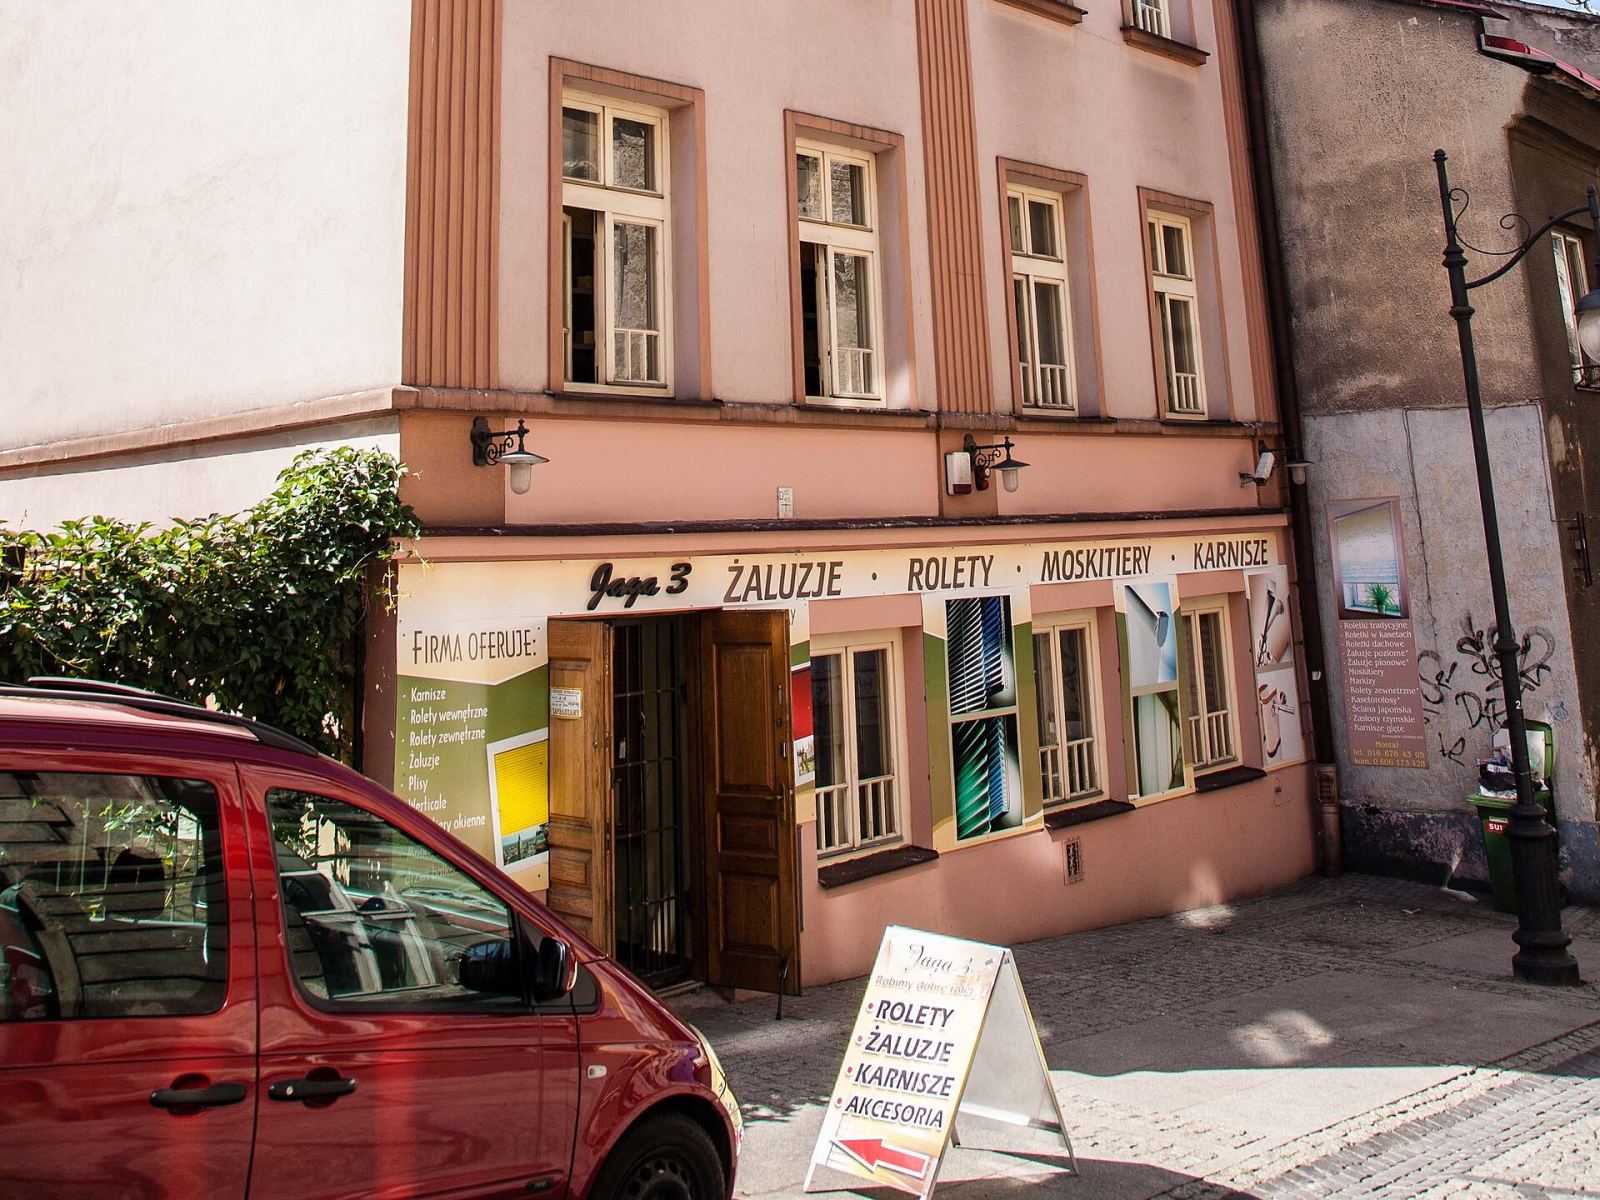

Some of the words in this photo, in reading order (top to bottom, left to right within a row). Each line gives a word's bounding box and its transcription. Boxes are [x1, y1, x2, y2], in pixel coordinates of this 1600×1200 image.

[723, 559, 843, 602] ŻALUZJE
[907, 555, 994, 591] ROLETY
[1041, 546, 1151, 581] MOSKITIERY
[1194, 539, 1268, 570] KARNISZE
[587, 562, 661, 611] Jaga
[665, 562, 692, 594] 3
[1344, 631, 1369, 639] Roletki
[1370, 621, 1408, 631] tradycyjne
[412, 630, 463, 664] FIRMA
[468, 629, 537, 661] OFERUJE:
[1345, 640, 1370, 648] Roletki
[1372, 640, 1405, 648] dachowe
[410, 687, 447, 702] Karnisze
[1350, 687, 1373, 695] Rolety
[410, 707, 438, 726] Rolety
[438, 703, 488, 722] wewnętrzne
[1515, 700, 1522, 709] 2
[409, 730, 437, 748] Rolety
[438, 725, 485, 744] zewnętrzne
[408, 751, 440, 770] Żaluzje
[408, 774, 429, 792] Plisy
[453, 813, 486, 830] okienne
[904, 944, 953, 976] Jaga
[957, 957, 973, 978] 3
[876, 1000, 955, 1028] ROLETY
[865, 1025, 955, 1062] ŻALUZJE
[854, 1063, 955, 1097] KARNISZE
[845, 1096, 944, 1128] AKCESORIA
